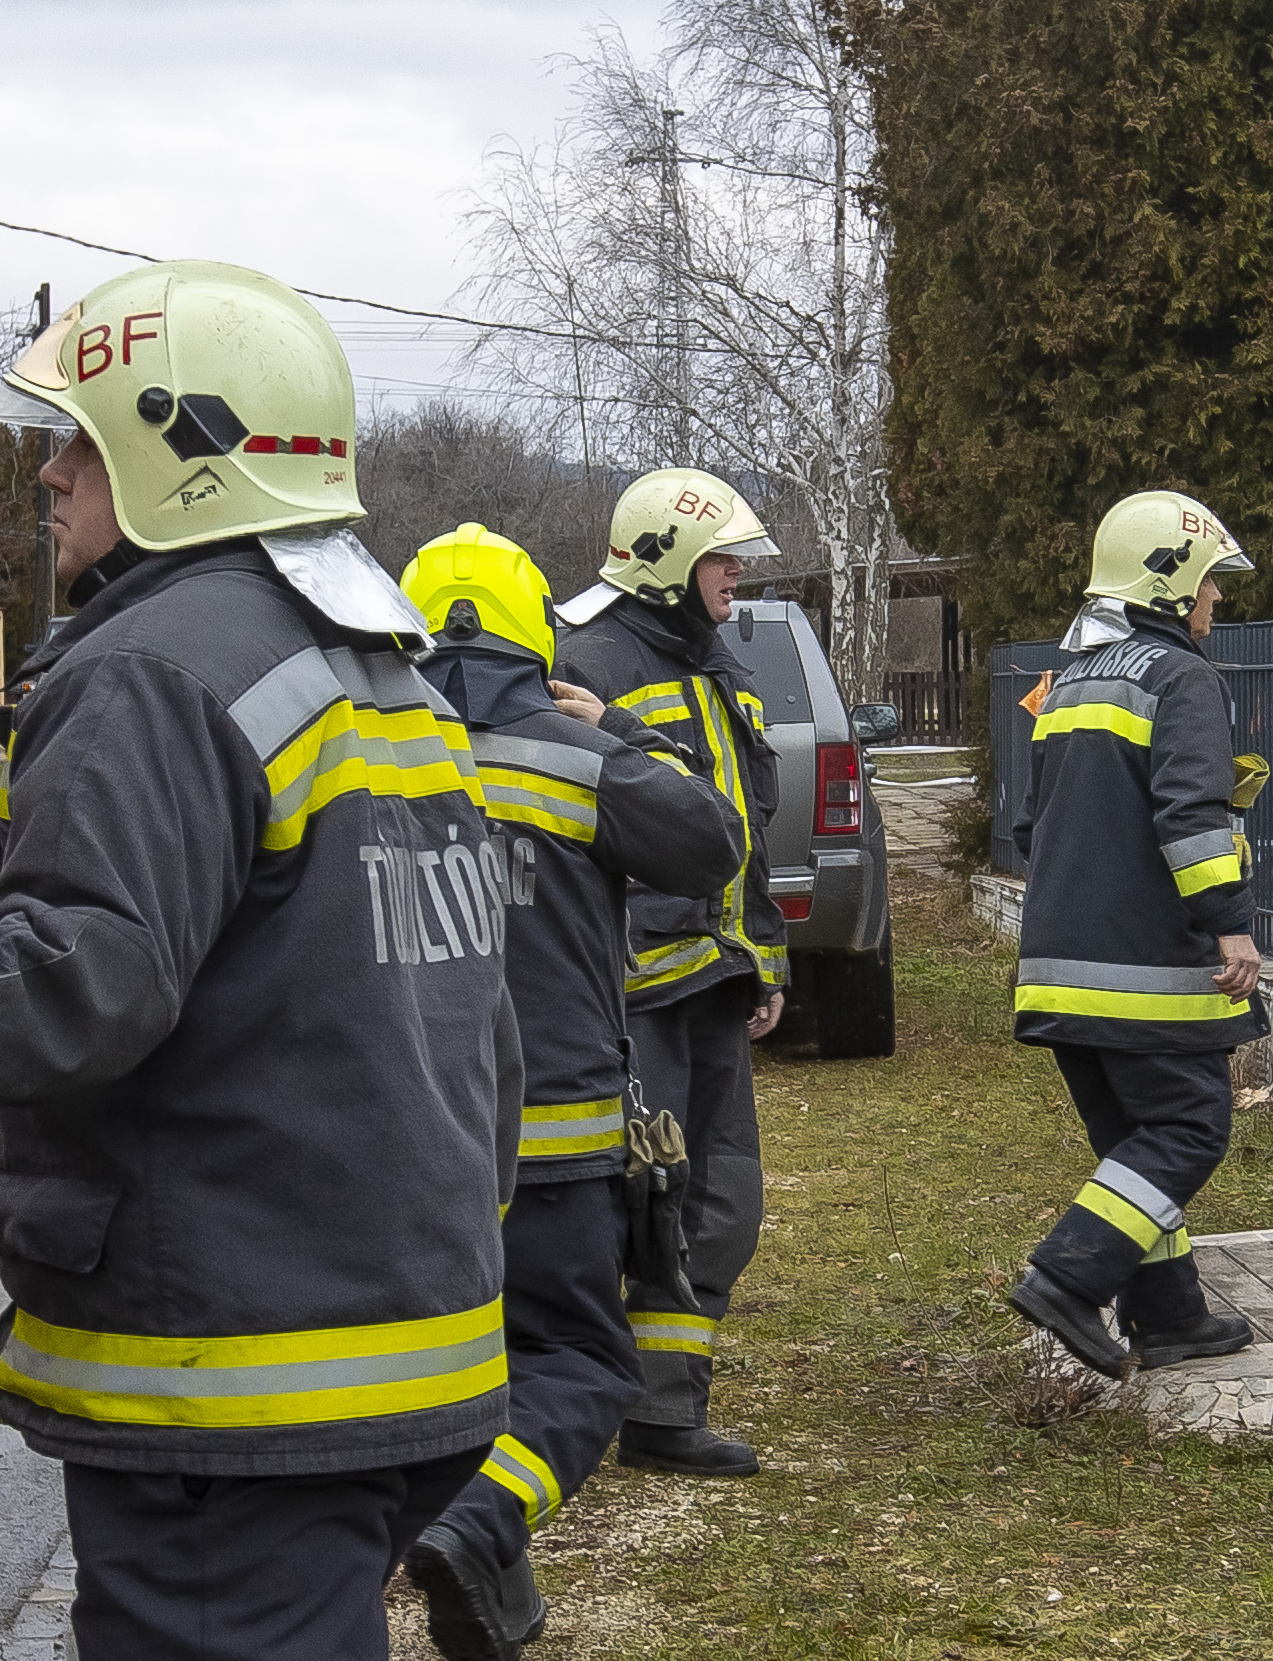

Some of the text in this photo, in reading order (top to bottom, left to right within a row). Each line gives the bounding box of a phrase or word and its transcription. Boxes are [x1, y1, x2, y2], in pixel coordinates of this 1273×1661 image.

[78, 312, 163, 383] BF
[674, 490, 722, 521] BF
[1182, 510, 1216, 539] BF
